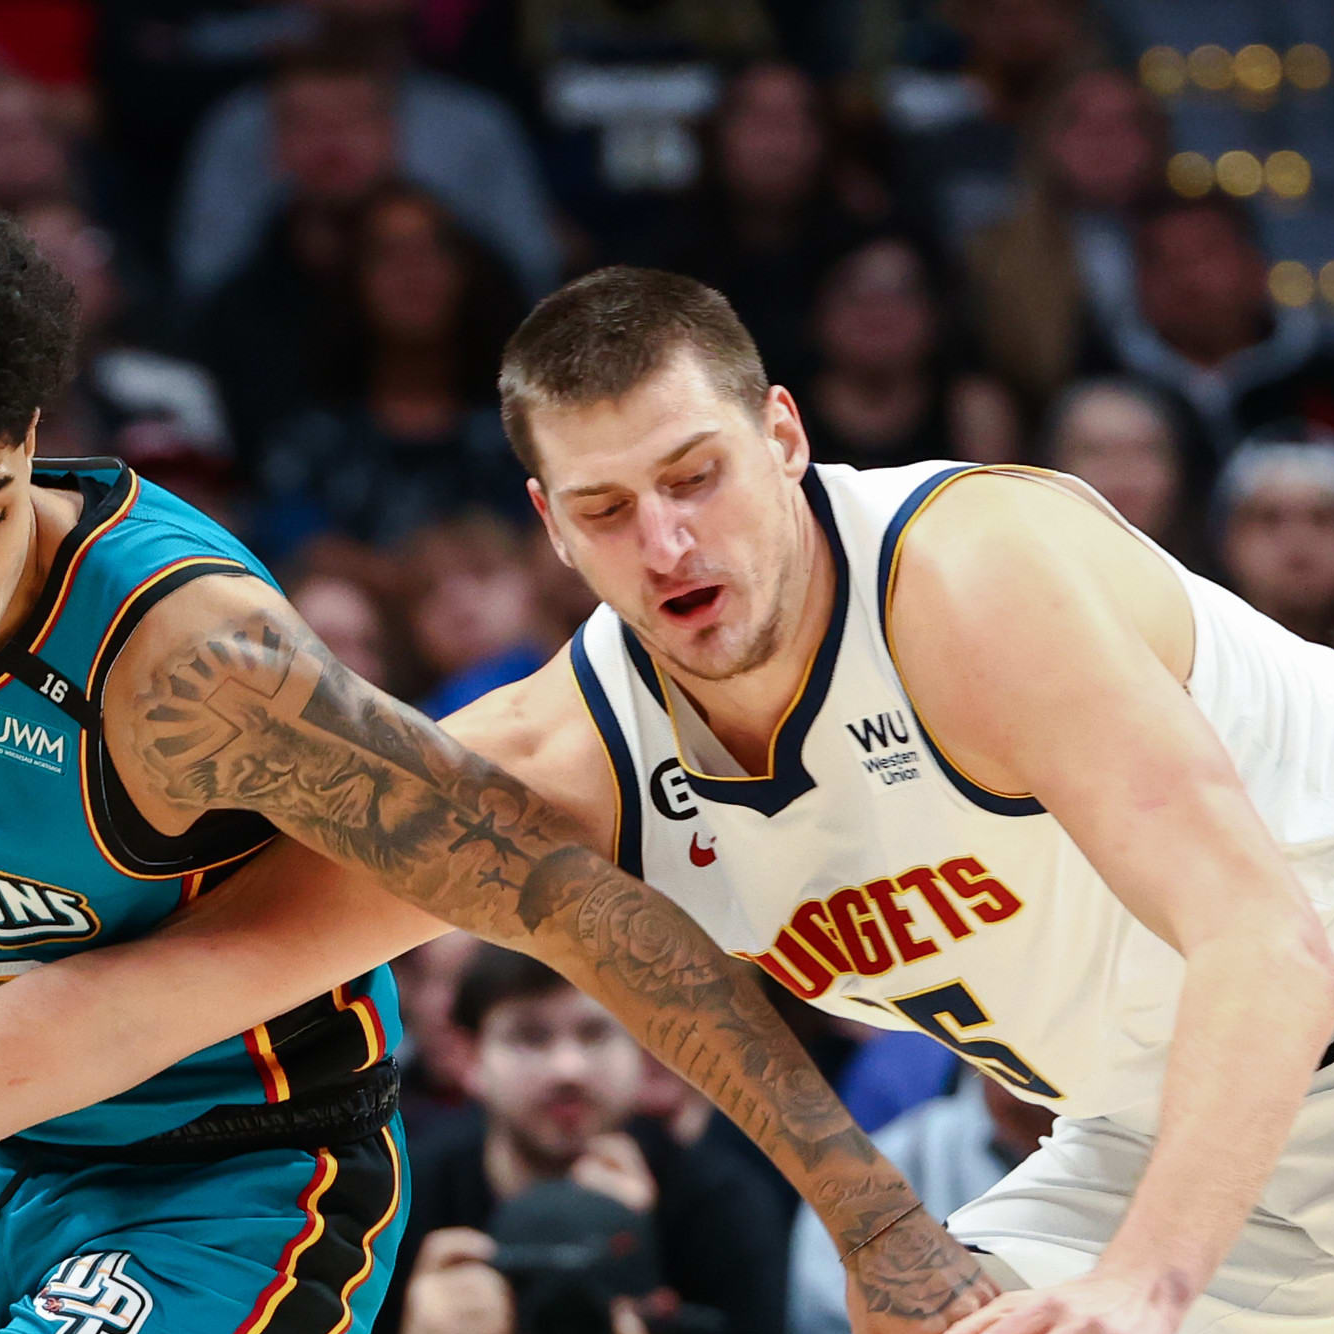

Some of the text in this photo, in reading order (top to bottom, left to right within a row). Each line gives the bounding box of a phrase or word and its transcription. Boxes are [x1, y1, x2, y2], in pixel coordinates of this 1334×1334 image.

[39, 672, 69, 703] 16
[845, 709, 909, 753] WU
[725, 853, 1025, 1001] UGGETS
[843, 977, 1068, 1101] 5
